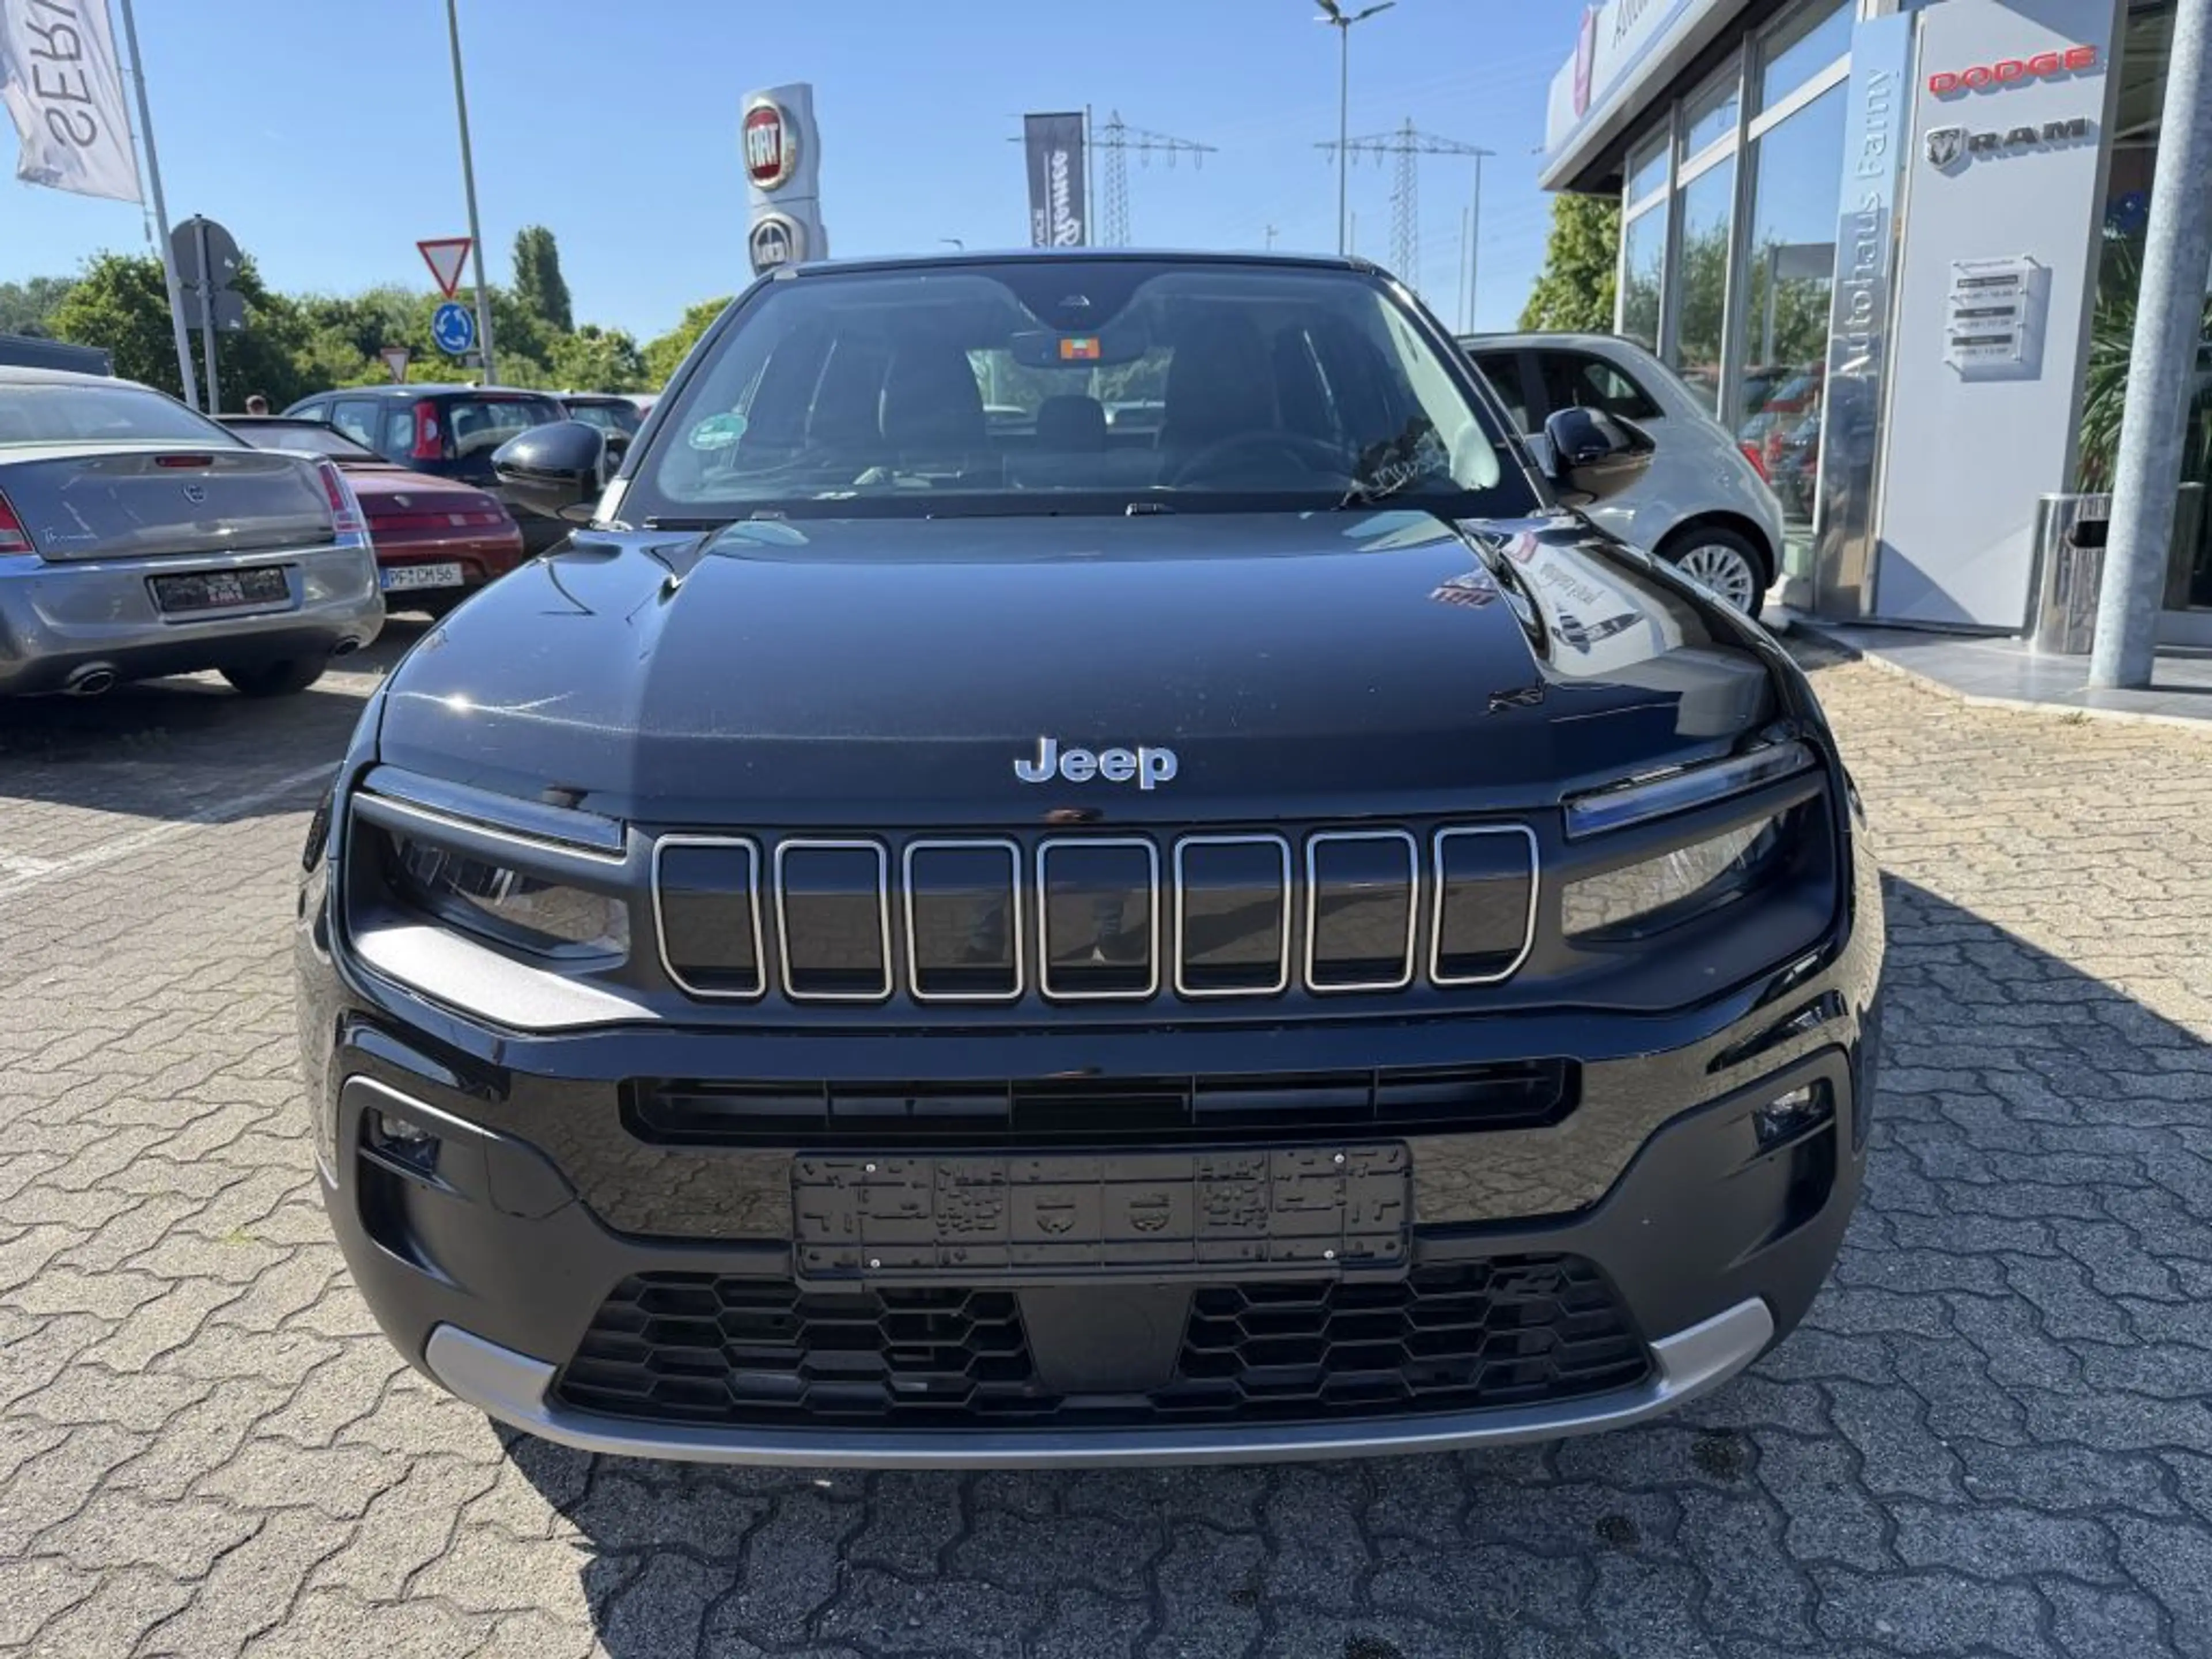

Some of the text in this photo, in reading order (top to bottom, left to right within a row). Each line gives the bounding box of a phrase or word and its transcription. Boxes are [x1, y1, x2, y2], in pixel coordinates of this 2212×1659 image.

[1929, 45, 2097, 93] DODGE
[747, 123, 779, 168] FIAT
[1968, 117, 2089, 152] RAM
[1840, 191, 1881, 380] Autohaus
[1014, 737, 1178, 789] Jeep
